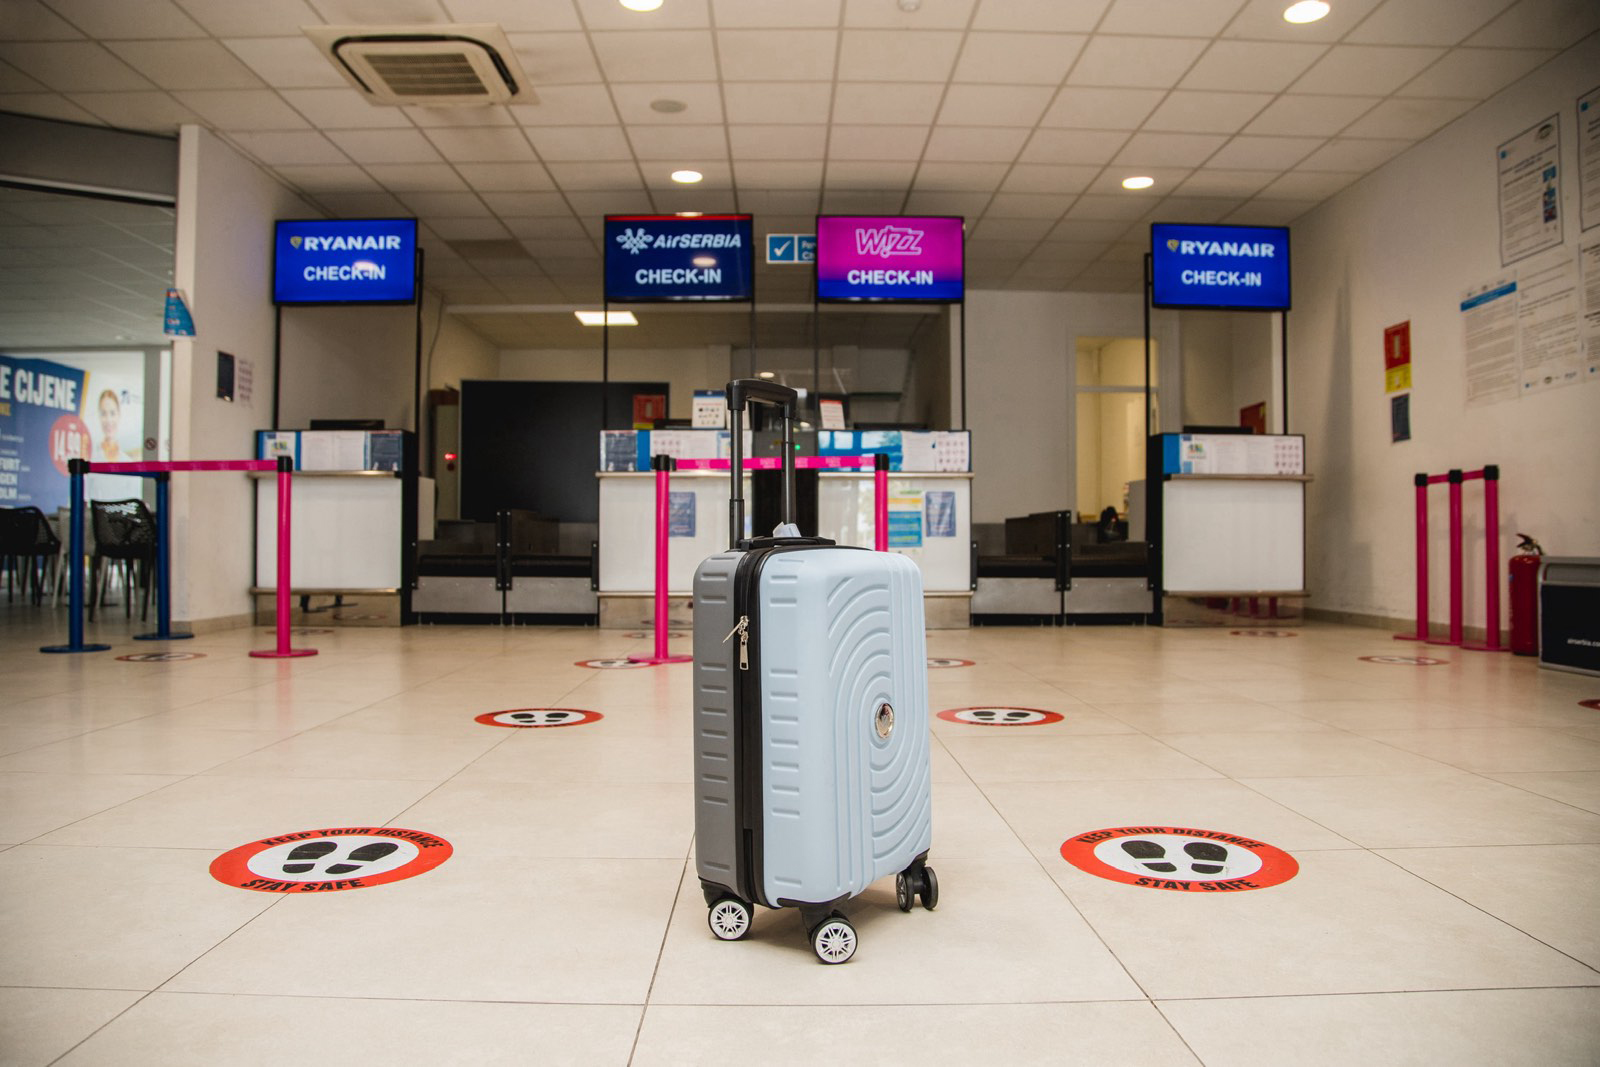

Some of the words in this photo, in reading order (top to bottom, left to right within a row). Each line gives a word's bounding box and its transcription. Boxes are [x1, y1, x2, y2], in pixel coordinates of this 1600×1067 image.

[304, 235, 401, 251] RYANAIR
[1181, 240, 1275, 257] RYANAIR
[303, 264, 386, 281] CHECK-IN
[635, 268, 722, 284] CHECK-IN
[847, 269, 934, 285] CHECK-IN
[1181, 270, 1262, 287] CHECK-IN
[15, 369, 77, 411] CIJENE
[260, 832, 311, 847] KEEP
[318, 828, 371, 837] YOUR
[374, 828, 444, 849] DISTANCE
[1075, 831, 1113, 844] KEEP
[1115, 827, 1167, 835] YOUR
[1173, 827, 1265, 850] DISTANCE
[241, 878, 298, 892] STAY
[301, 878, 365, 891] SAFE
[1133, 877, 1192, 891] STAY
[1198, 879, 1260, 892] SAFE
